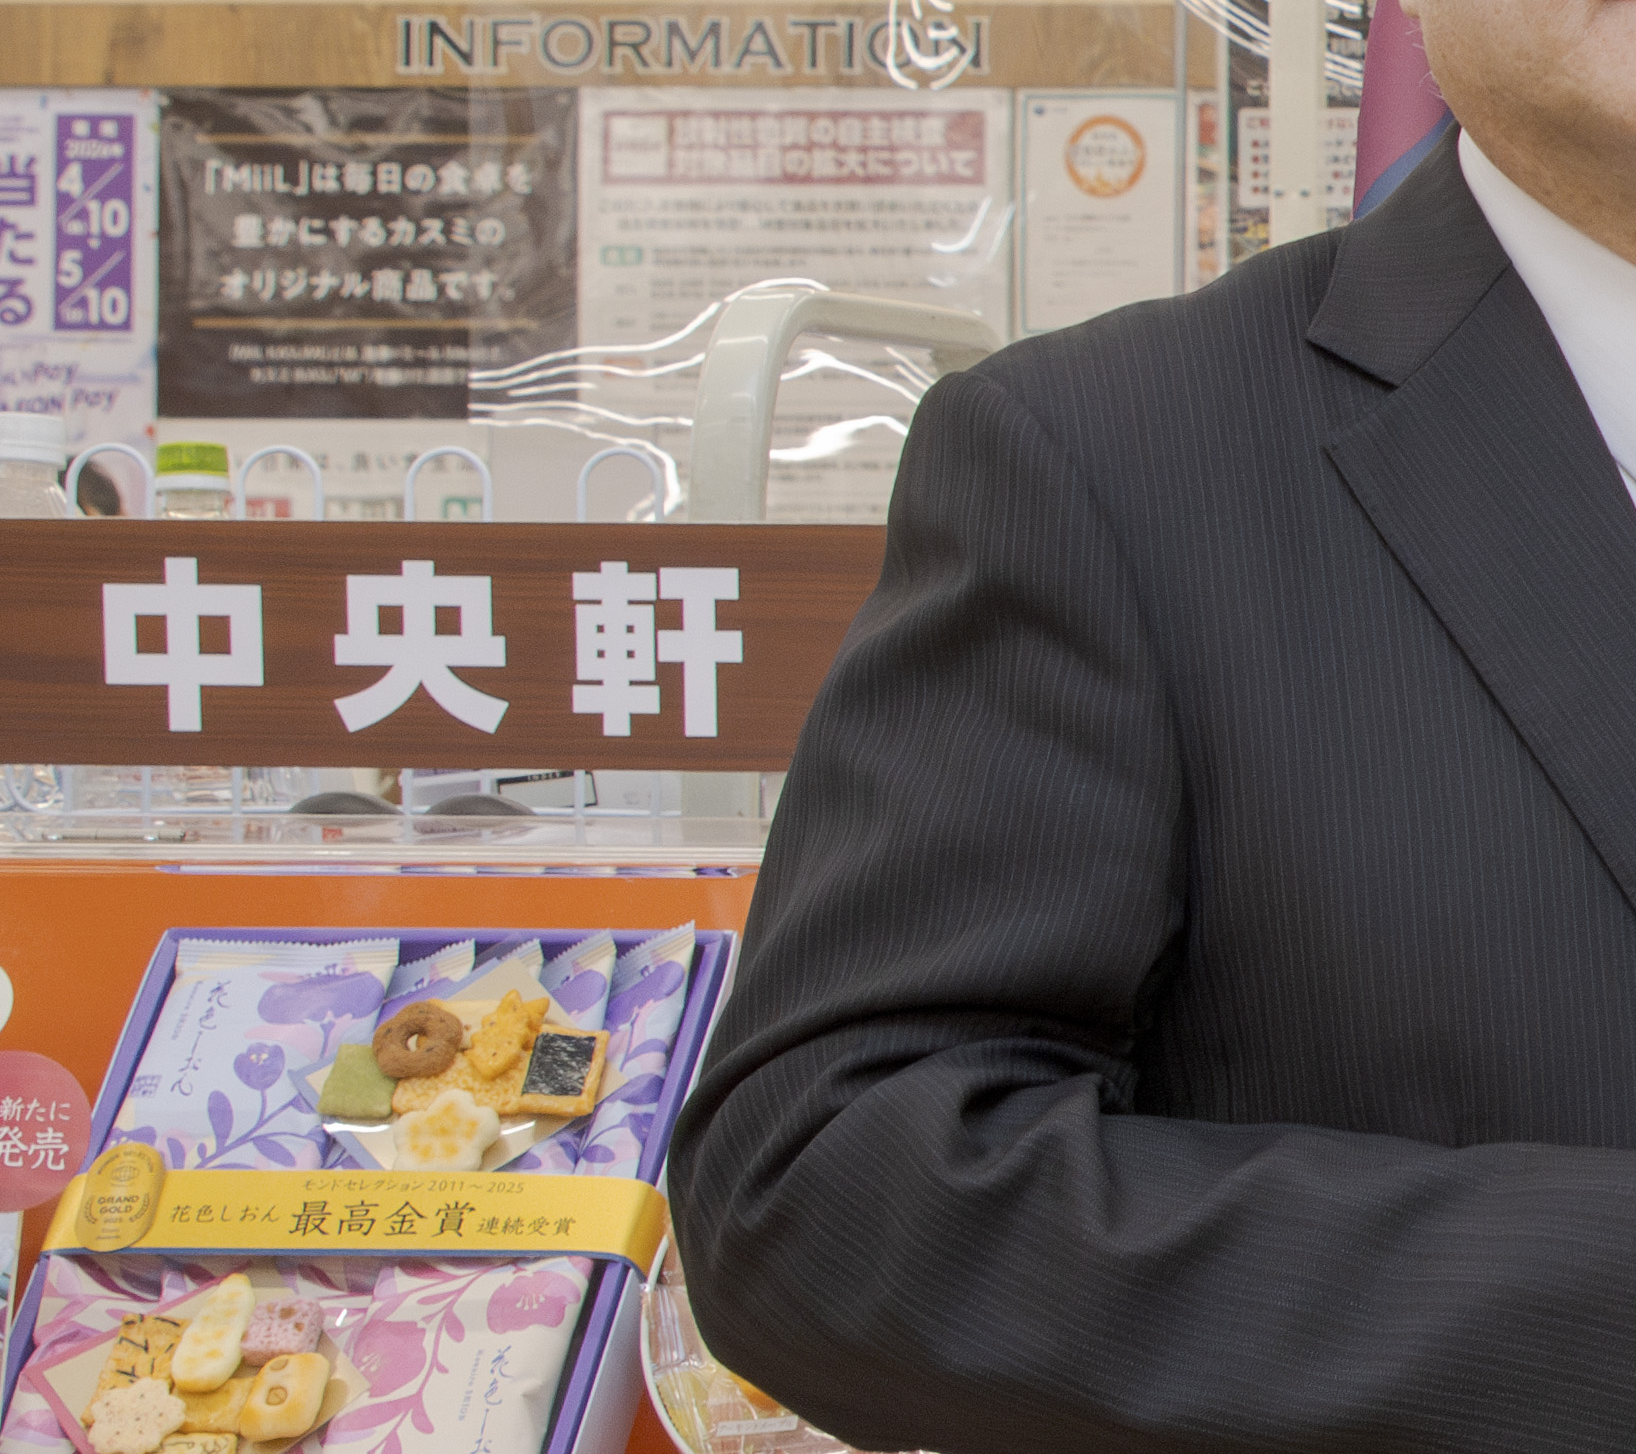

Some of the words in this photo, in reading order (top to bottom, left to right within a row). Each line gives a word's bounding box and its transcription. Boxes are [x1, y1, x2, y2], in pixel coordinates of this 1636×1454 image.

[397, 12, 992, 78] INFORMATION
[102, 556, 744, 737] 中央軒
[0, 1097, 70, 1122] 新たに
